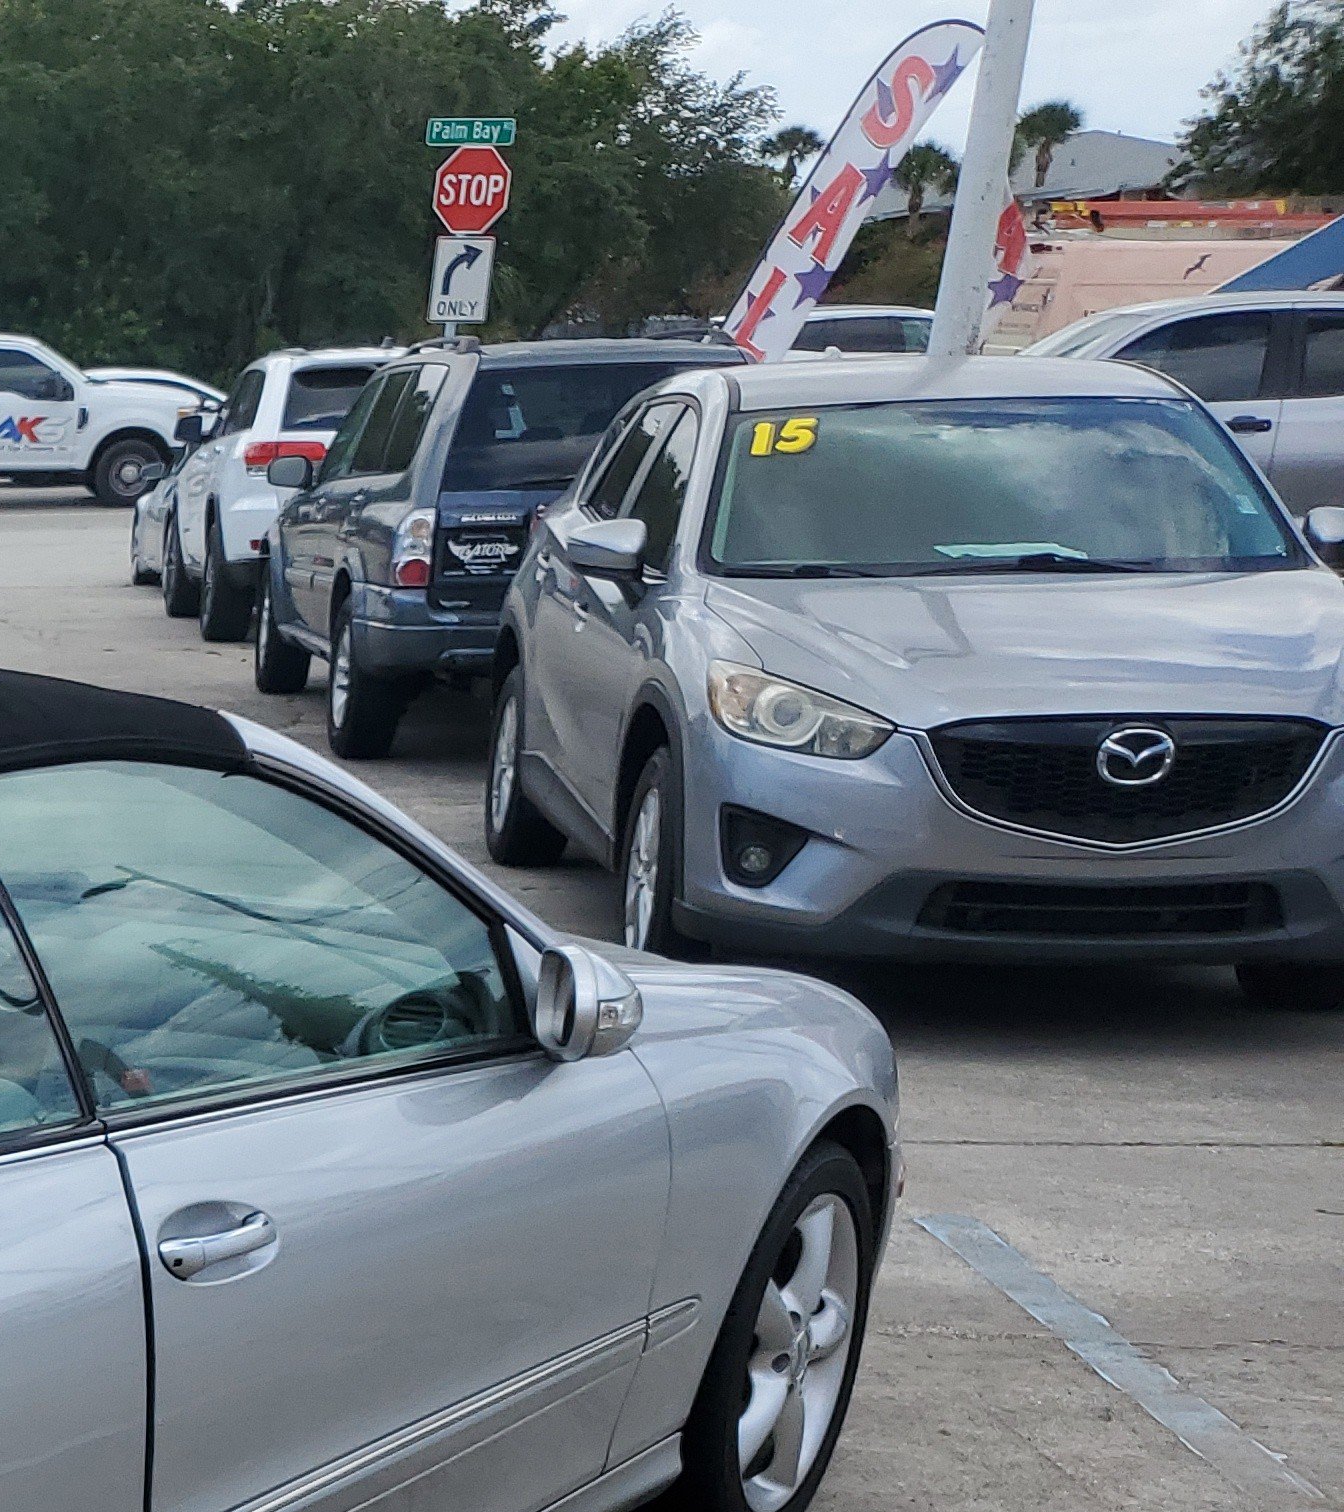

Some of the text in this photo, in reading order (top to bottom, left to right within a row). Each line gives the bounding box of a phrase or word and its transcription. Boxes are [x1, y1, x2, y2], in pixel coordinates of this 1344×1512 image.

[431, 120, 468, 140] Palm
[472, 121, 501, 143] Bay
[439, 172, 505, 206] STOP
[435, 300, 479, 316] ONLY
[750, 417, 818, 456] 15
